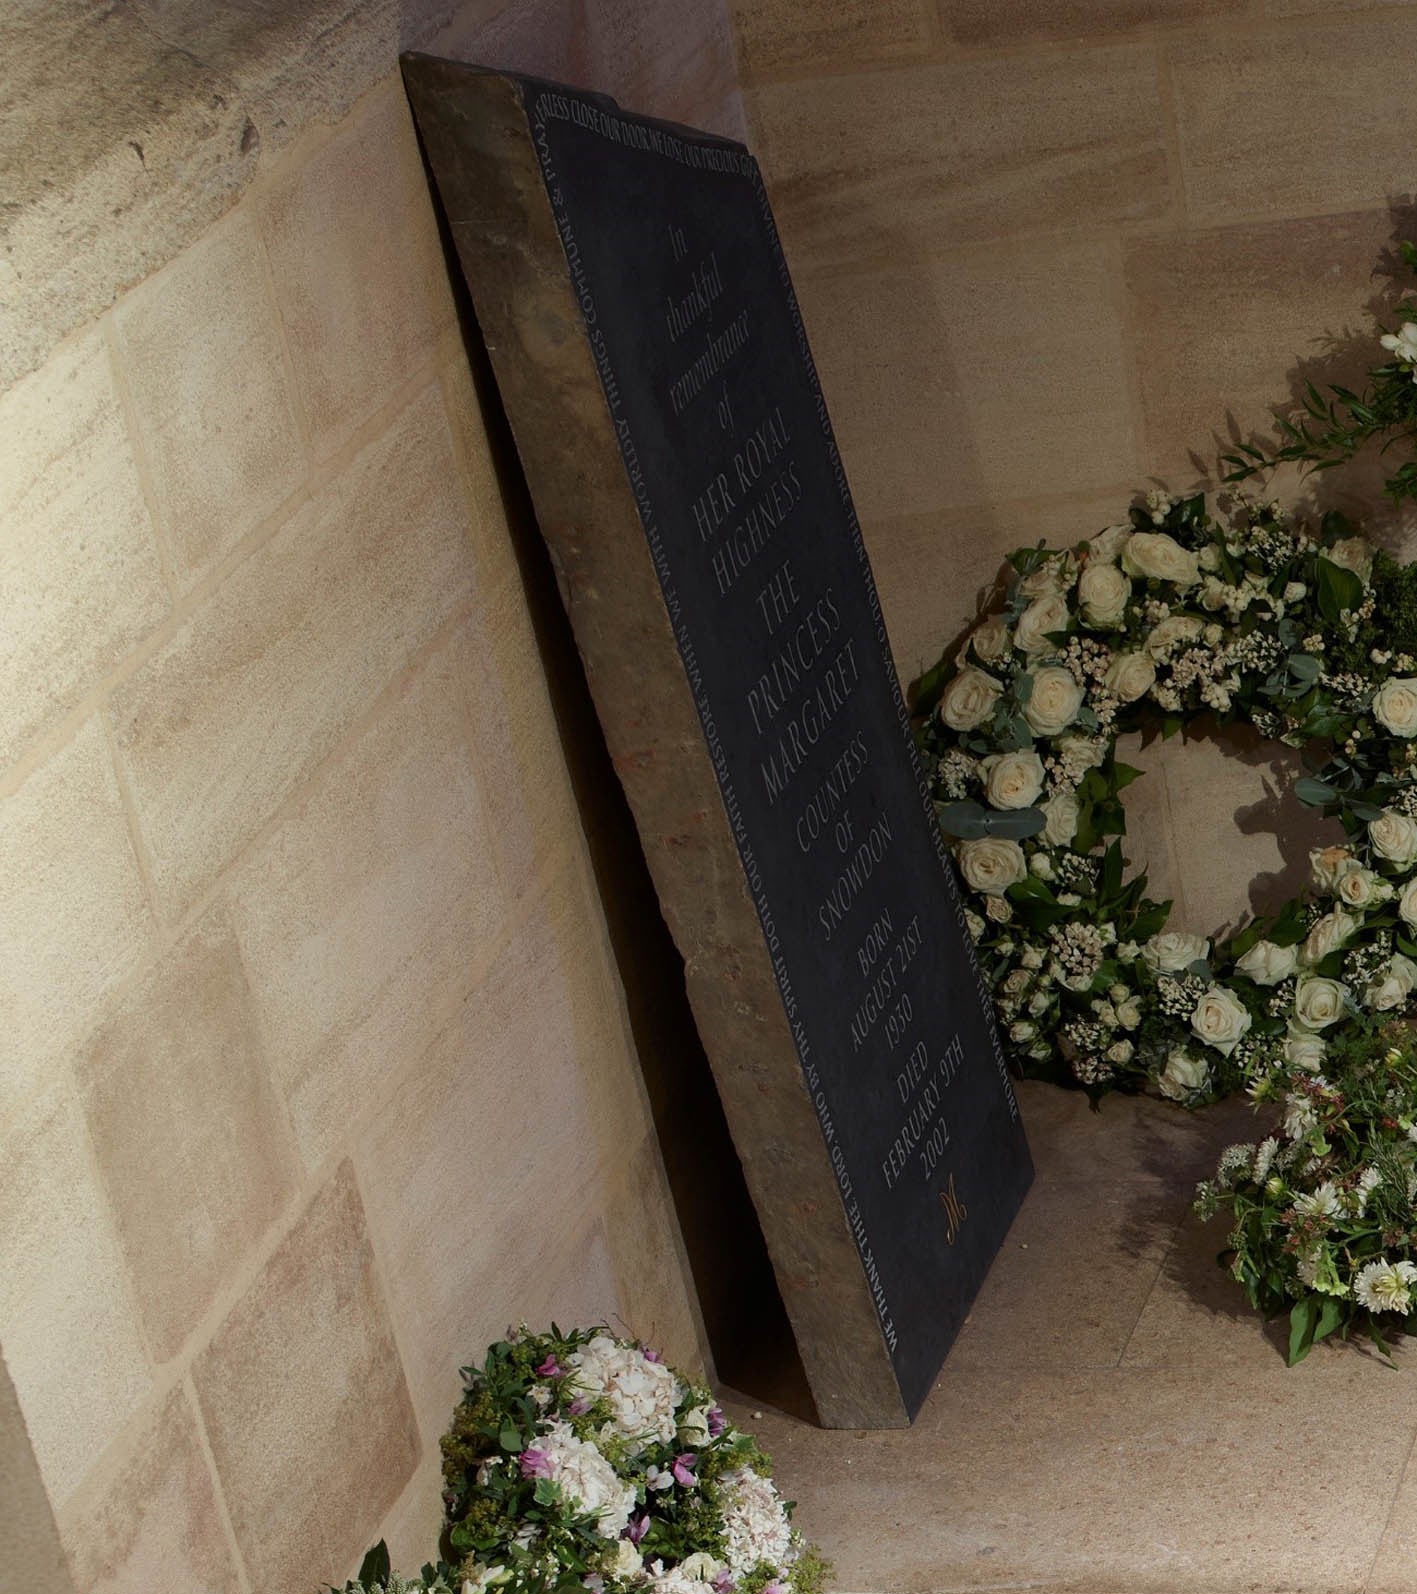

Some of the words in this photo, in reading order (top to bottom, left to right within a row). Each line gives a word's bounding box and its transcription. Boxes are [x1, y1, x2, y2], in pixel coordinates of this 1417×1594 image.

[569, 99, 601, 134] CLOSE
[600, 111, 621, 143] OUR
[557, 214, 598, 325] COMMUNE
[667, 222, 689, 263] In
[665, 249, 723, 342] thankful
[590, 329, 622, 411] THINGS
[669, 308, 750, 417] remembrance
[718, 379, 735, 438] of
[615, 417, 655, 523] WORLDLY
[690, 472, 736, 541] HER
[733, 407, 791, 494] ROYAL
[648, 525, 672, 586] WITH
[711, 461, 801, 595] HIGHNESS
[755, 559, 800, 636] THE
[678, 623, 702, 695] WHEN
[746, 587, 841, 735] PRINCESS
[760, 637, 859, 806] MARGARET
[724, 784, 749, 842] FAITH
[796, 730, 871, 852] COUNTESS
[919, 782, 937, 827] OUR
[835, 810, 854, 854] OF
[930, 828, 958, 900] HEARTS
[742, 843, 763, 893] OUR
[818, 811, 892, 941] SNOWDON
[757, 893, 779, 953] DOTH
[857, 906, 893, 977] BORN
[775, 955, 799, 1020] SPIRIT
[850, 957, 897, 1053] AUGUST
[884, 992, 913, 1050] 1930
[792, 1021, 812, 1062] THY
[896, 1041, 928, 1103] DIED
[805, 1063, 821, 1091] BY
[881, 1072, 941, 1190] FEBRUARY
[939, 1032, 965, 1088] 9TH
[814, 1090, 836, 1144] WHO
[919, 1117, 950, 1180] 2002
[863, 1248, 890, 1320] THANK
[884, 1317, 899, 1352] WE
